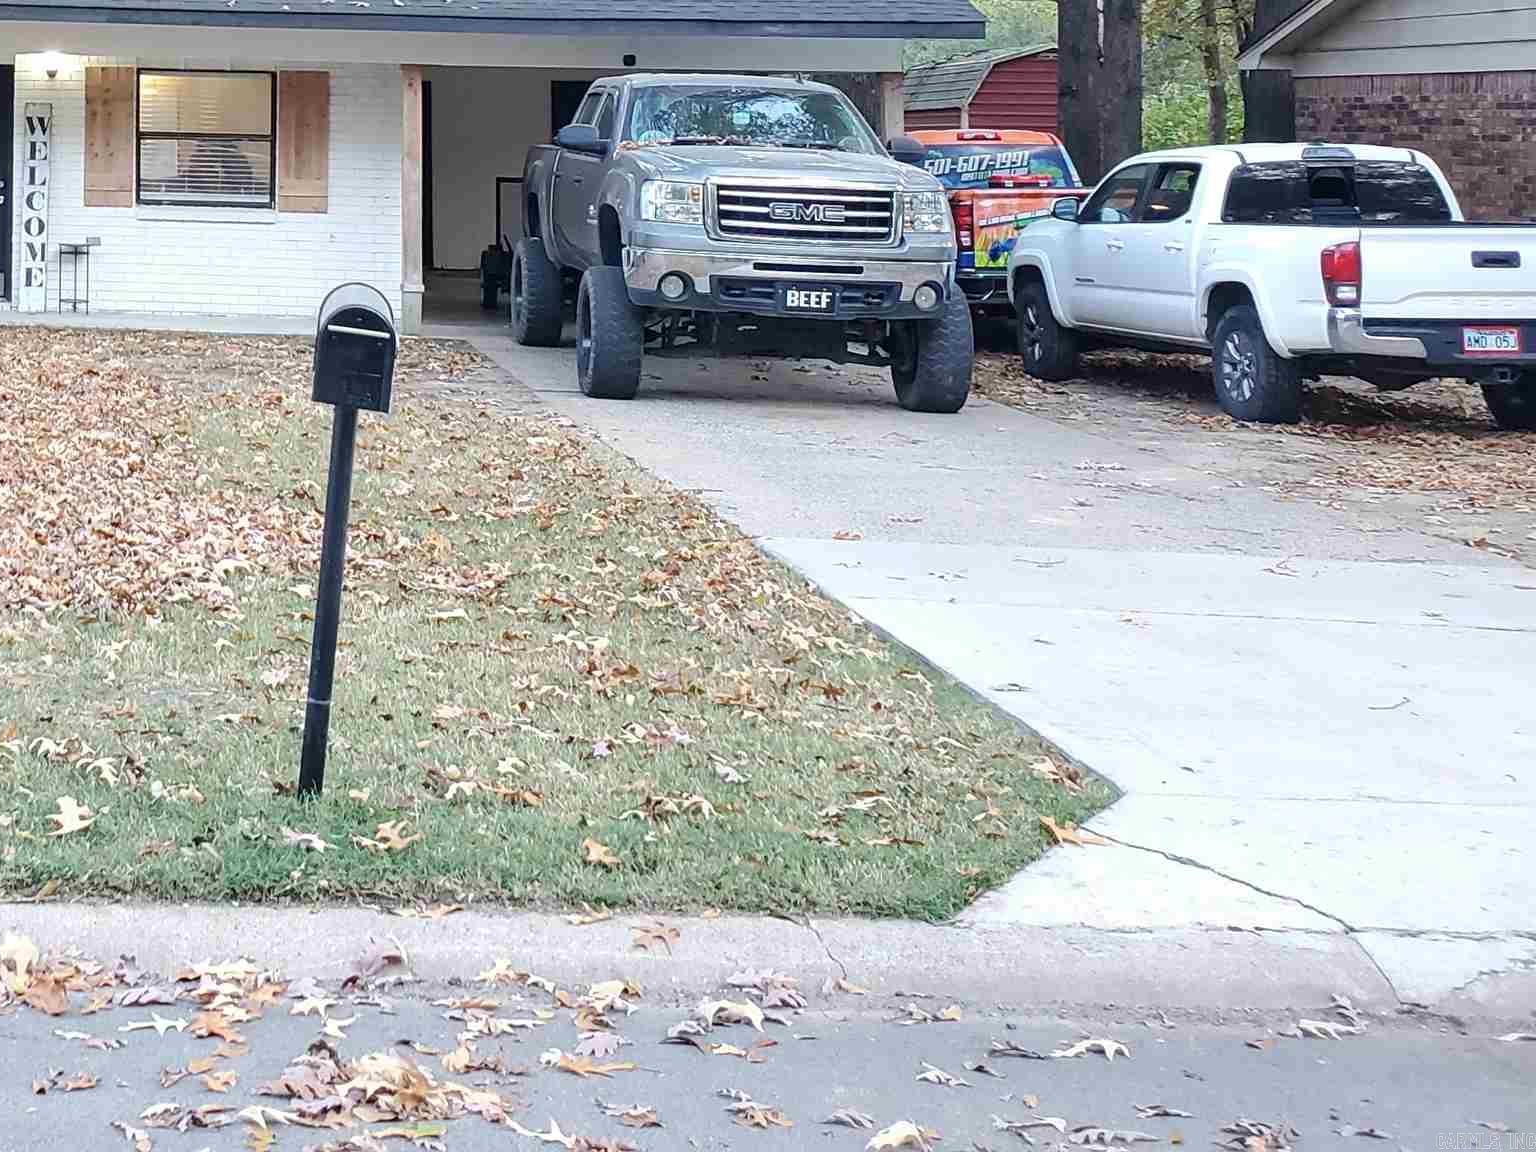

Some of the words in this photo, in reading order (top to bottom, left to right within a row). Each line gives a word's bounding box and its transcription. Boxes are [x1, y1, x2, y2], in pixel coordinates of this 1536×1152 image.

[25, 116, 52, 288] WELCOME
[769, 202, 846, 222] GMC
[786, 290, 833, 308] BEEF
